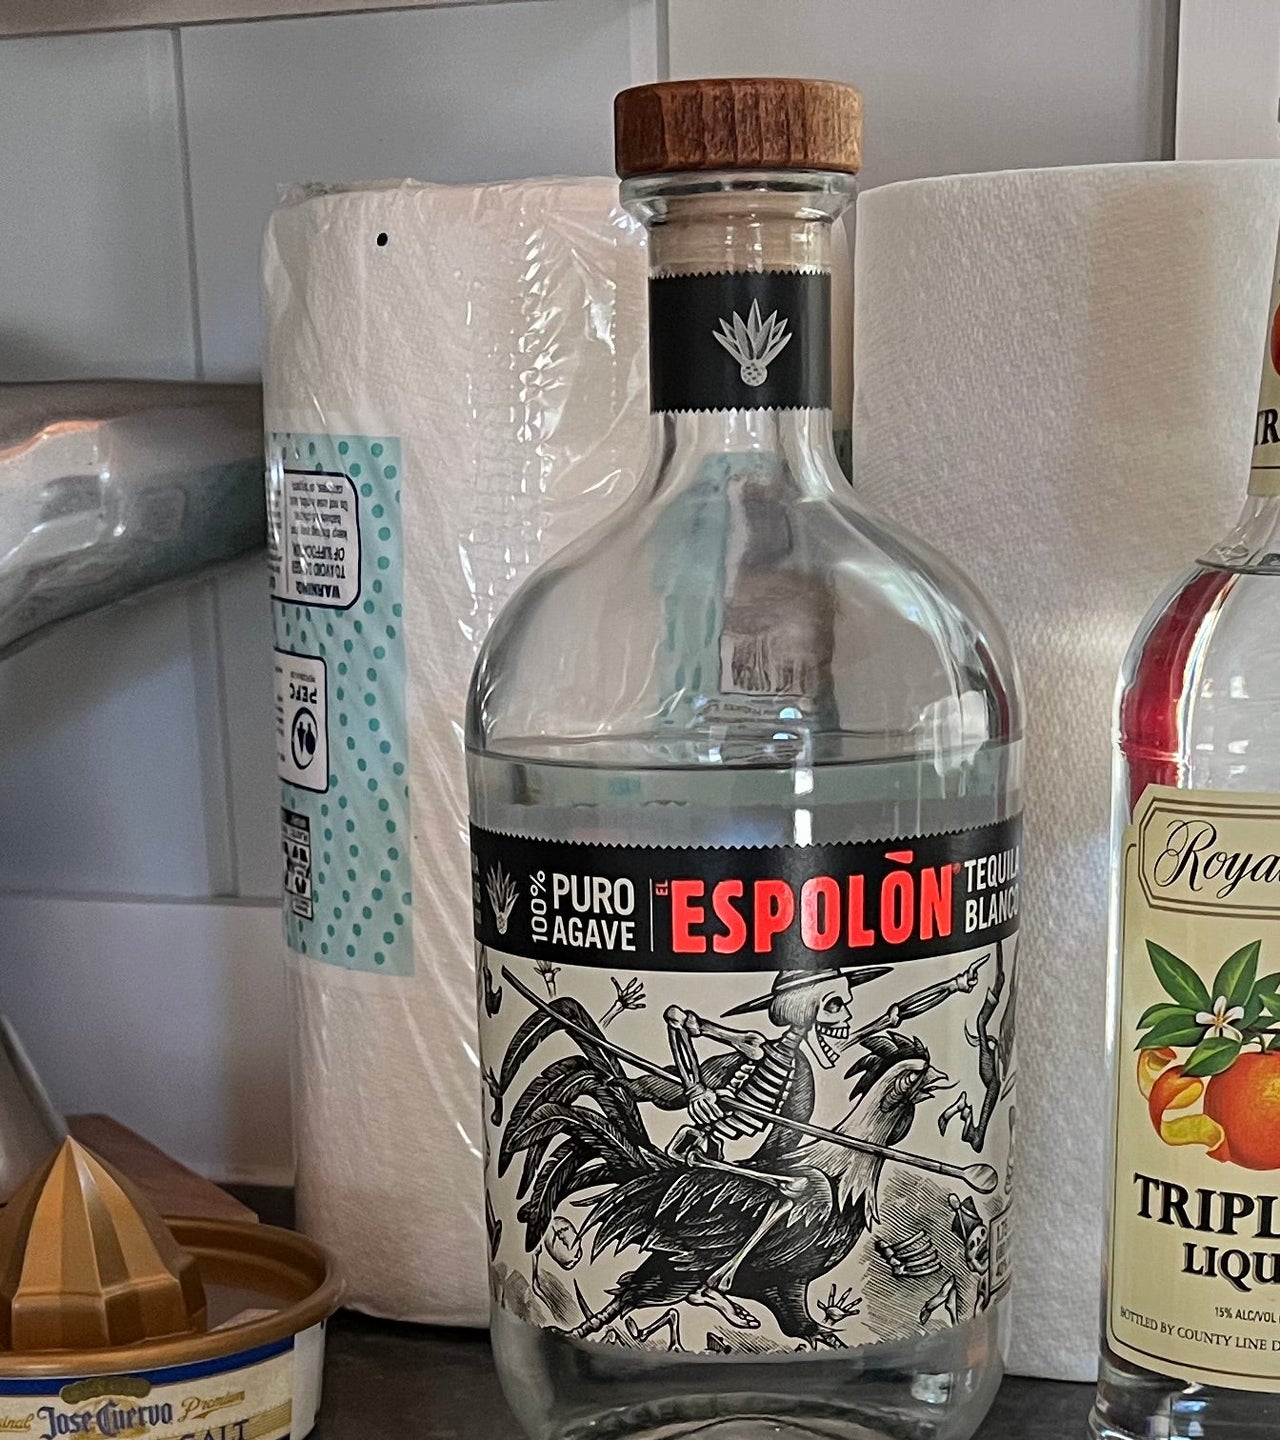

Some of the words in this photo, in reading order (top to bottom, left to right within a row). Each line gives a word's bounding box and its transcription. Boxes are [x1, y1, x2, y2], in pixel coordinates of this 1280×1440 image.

[529, 869, 549, 944] 100%
[552, 872, 636, 917] PURO
[655, 880, 669, 896] EL
[965, 883, 1020, 934] BLANCO
[551, 915, 637, 952] AGAVE
[1120, 1305, 1159, 1331] BOTTLED
[1160, 1321, 1176, 1336] BY
[1177, 1326, 1233, 1347] COUNTY
[1234, 1336, 1268, 1351] LINE
[1214, 1306, 1233, 1319] 15%
[1234, 1308, 1277, 1324] ALC/VOL
[96, 1399, 173, 1438] Cuervo
